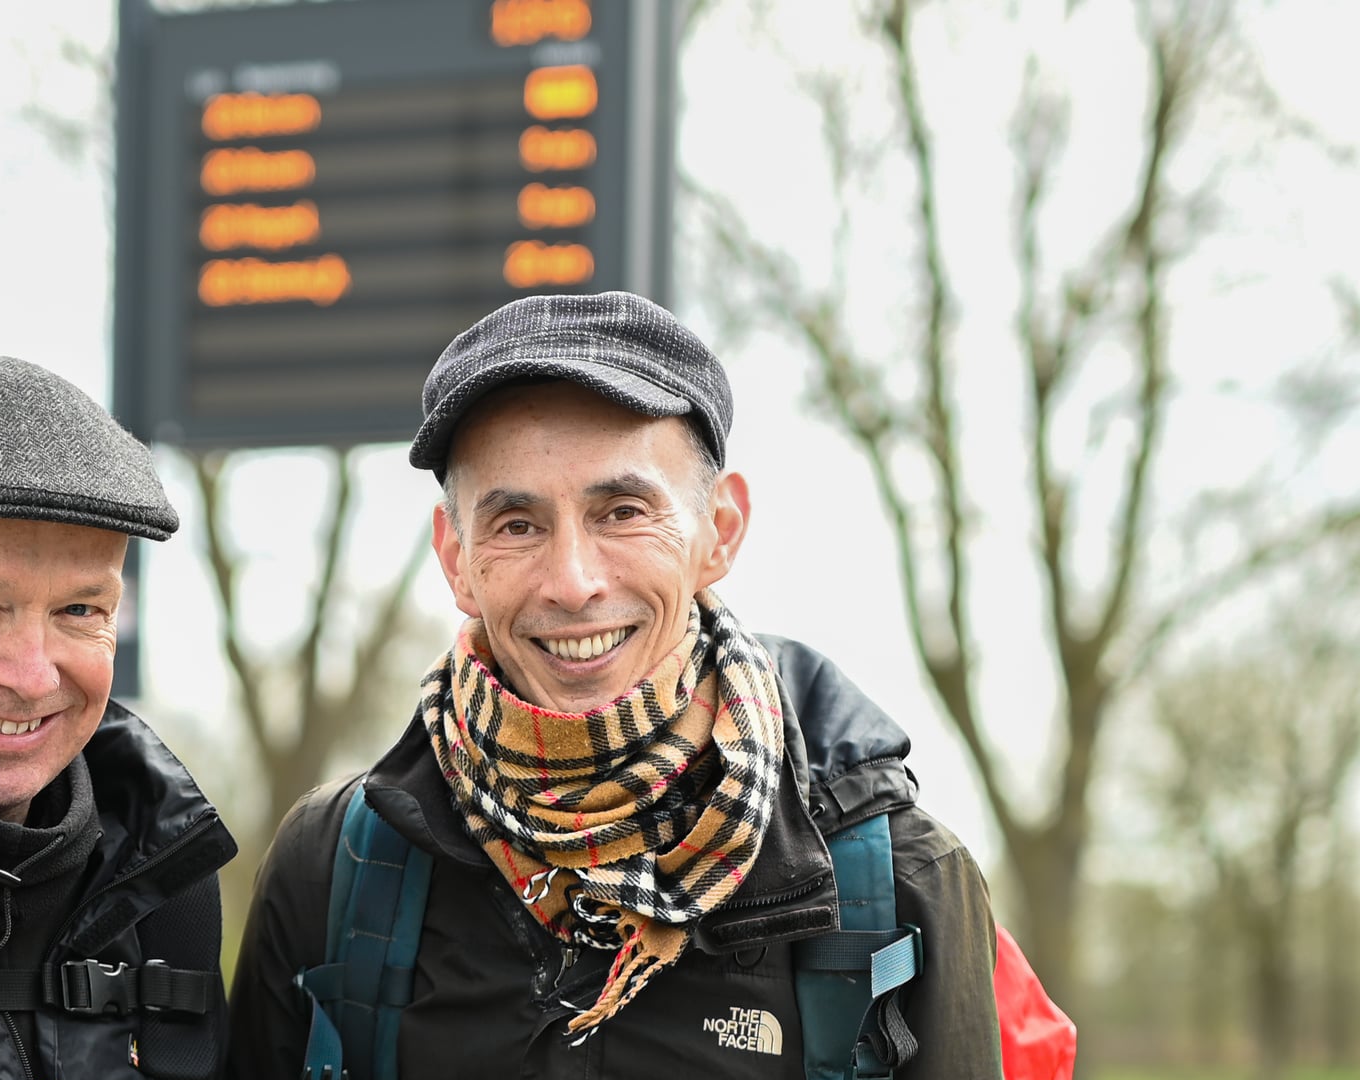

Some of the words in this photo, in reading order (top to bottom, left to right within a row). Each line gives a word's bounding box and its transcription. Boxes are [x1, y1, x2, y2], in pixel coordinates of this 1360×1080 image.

[729, 1006, 760, 1024] THE
[703, 1018, 759, 1037] NORTH
[718, 1033, 757, 1051] FACE
